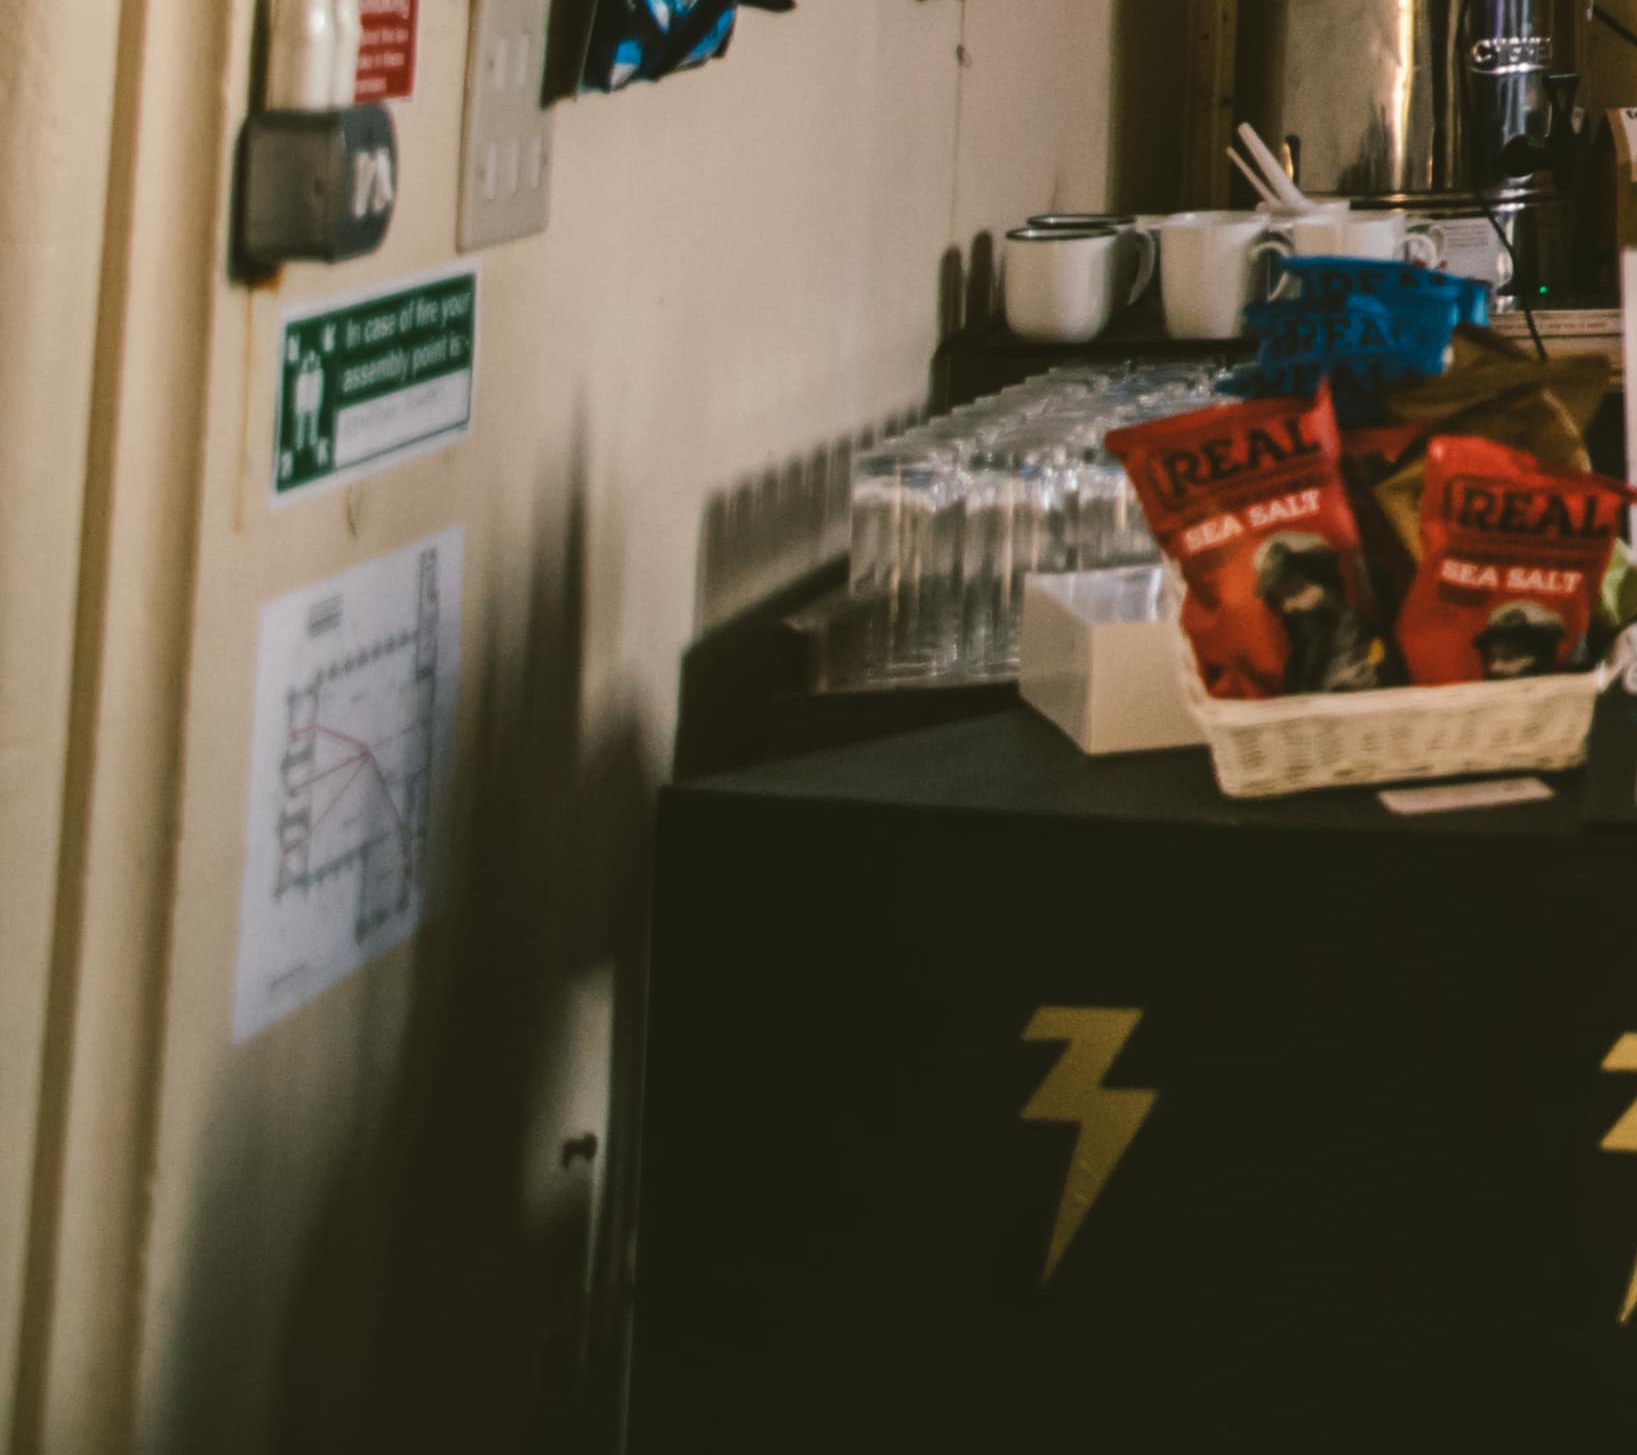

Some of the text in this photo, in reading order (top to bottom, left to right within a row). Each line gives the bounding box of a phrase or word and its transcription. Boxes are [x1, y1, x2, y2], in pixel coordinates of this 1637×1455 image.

[1164, 418, 1322, 498] REAL
[1183, 489, 1321, 554] SEA SALT
[1457, 488, 1611, 537] REAL
[1441, 558, 1583, 594] SEA SALT
